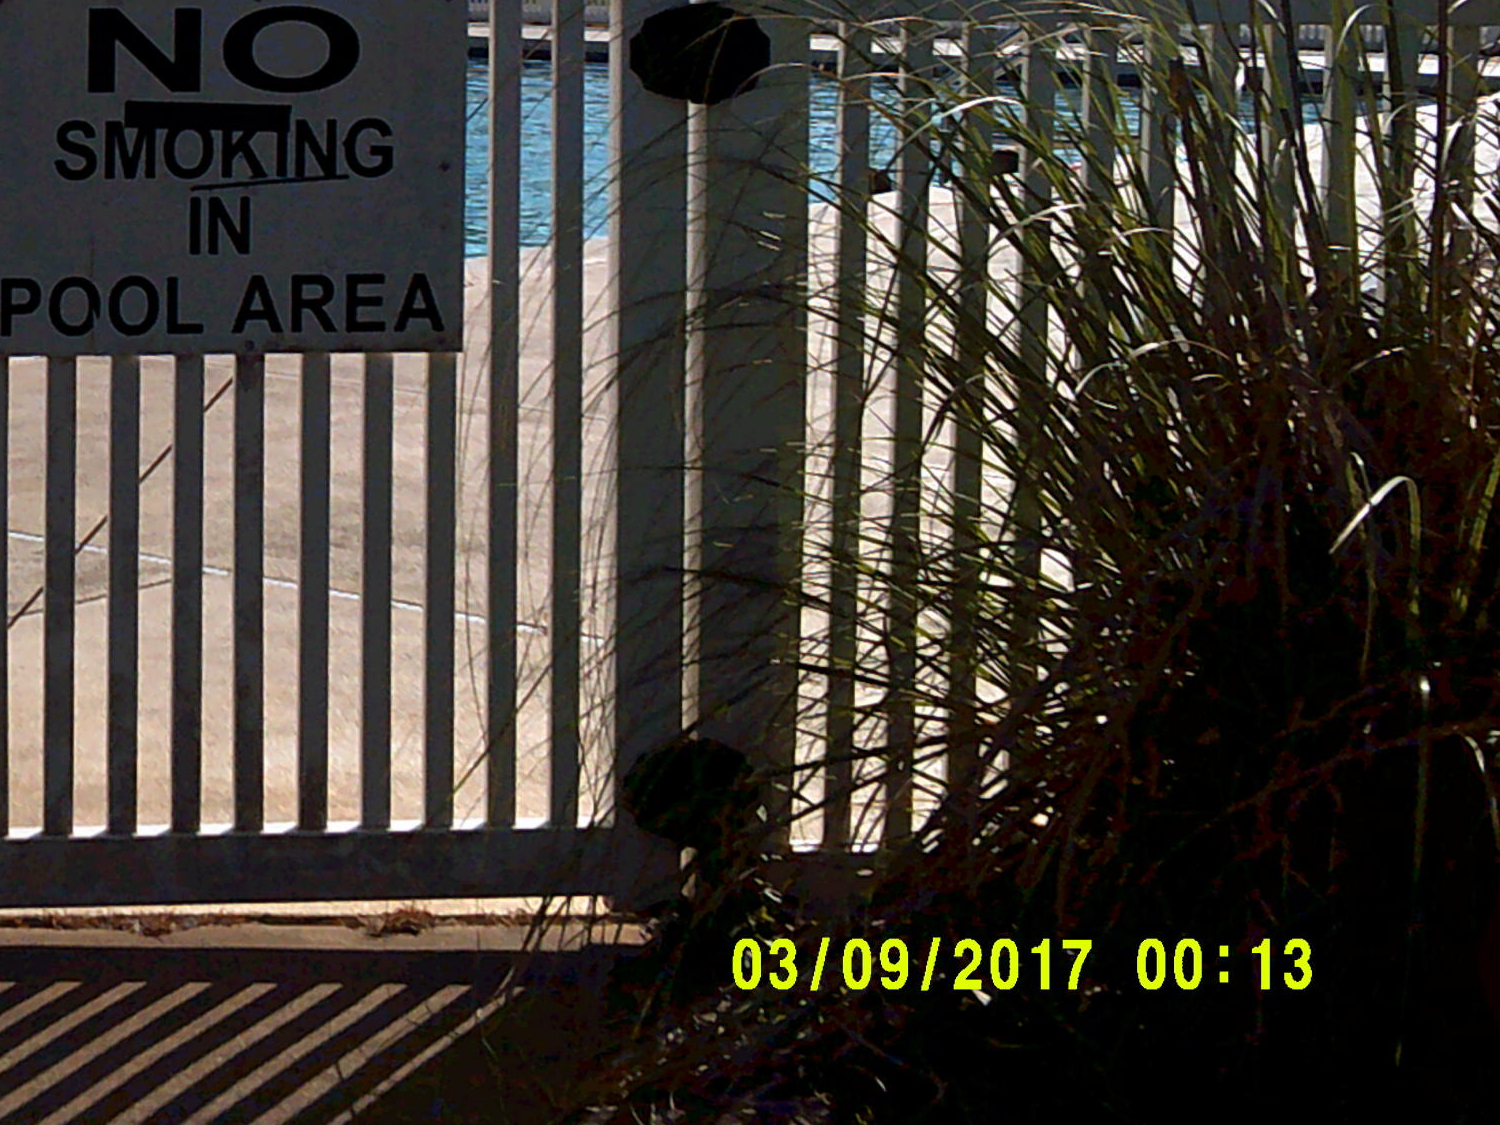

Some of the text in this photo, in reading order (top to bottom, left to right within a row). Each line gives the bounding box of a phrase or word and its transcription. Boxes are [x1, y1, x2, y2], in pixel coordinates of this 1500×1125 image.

[87, 5, 361, 93] NO
[53, 118, 394, 181] SMOKING
[189, 196, 251, 255] IN
[0, 273, 445, 337] POOL AREA
